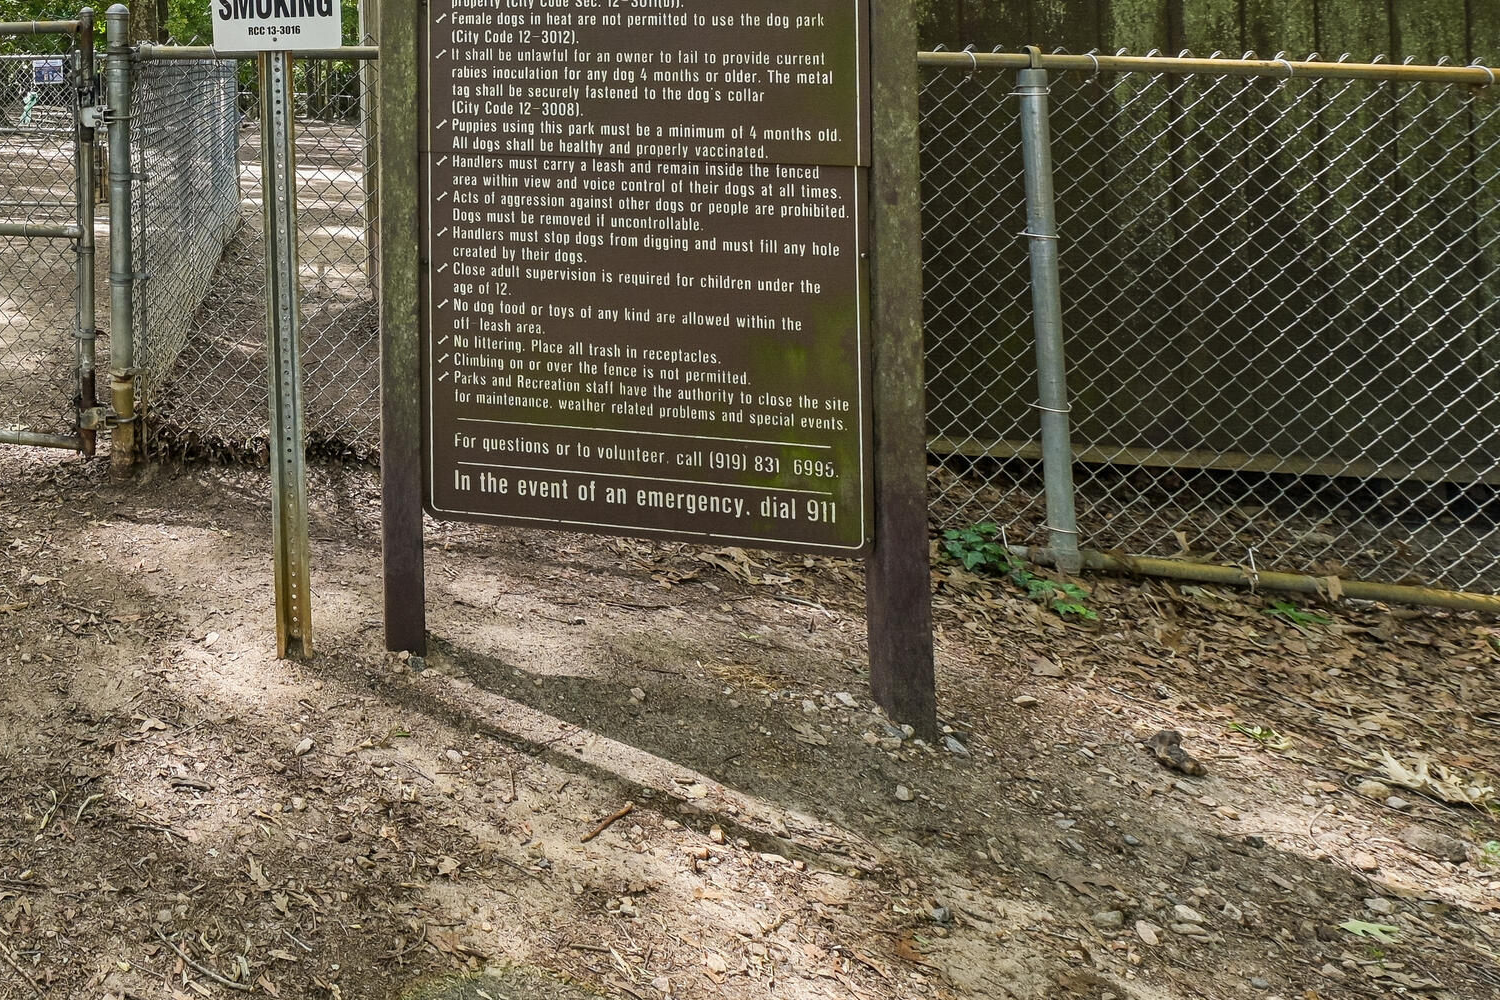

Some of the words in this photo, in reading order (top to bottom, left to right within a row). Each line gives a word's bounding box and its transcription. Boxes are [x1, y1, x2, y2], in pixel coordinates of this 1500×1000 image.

[248, 27, 266, 36] RCC
[267, 25, 301, 36] 13-3016
[451, 29, 479, 45] (City
[484, 29, 513, 43] Code
[451, 83, 470, 98] tag
[475, 83, 503, 96] shall
[508, 83, 522, 97] be
[527, 84, 579, 100] securely
[585, 84, 638, 99] fastened
[643, 86, 655, 100] to
[662, 86, 681, 100] the
[687, 86, 721, 103] dog's
[727, 87, 764, 102] collar
[451, 99, 479, 116] (City
[484, 100, 513, 115] Code
[451, 117, 497, 134] Puppies
[502, 119, 534, 135] using
[539, 119, 562, 134] this
[568, 121, 594, 137] park
[600, 122, 630, 136] must
[636, 122, 650, 136] be
[656, 125, 662, 137] a
[668, 123, 725, 138] minimum
[731, 125, 743, 139] of
[749, 125, 757, 139] 4
[763, 126, 811, 141] months
[817, 127, 841, 142] old.
[452, 135, 467, 149] All
[472, 136, 500, 152] dogs
[505, 137, 534, 151] shall
[539, 137, 553, 152] be
[559, 138, 603, 155] healthy
[609, 140, 630, 154] and
[636, 141, 688, 158] properly
[694, 143, 768, 158] vaccinated.
[452, 189, 479, 204] Acts
[484, 190, 495, 204] of
[500, 191, 564, 209] aggression
[570, 194, 612, 211] against
[618, 195, 650, 210] other
[655, 197, 684, 214] dogs
[690, 201, 703, 212] or
[708, 199, 748, 216] people
[754, 203, 774, 215] are
[780, 202, 849, 220] prohibited.
[453, 282, 473, 296] age
[478, 280, 489, 294] of
[494, 281, 511, 296] 12.
[453, 334, 468, 348] No
[474, 335, 525, 354] littering.
[531, 338, 563, 354] Place
[568, 341, 582, 355] all
[588, 342, 620, 358] trash
[626, 344, 637, 358] in
[643, 346, 721, 366] receptacles.
[454, 431, 476, 449] For
[482, 434, 549, 457] questions
[556, 443, 570, 456] or
[576, 441, 590, 458] to
[676, 449, 701, 467] call
[709, 450, 746, 471] (919)
[454, 469, 470, 491] In
[479, 471, 508, 494] the
[517, 475, 568, 499] event
[577, 479, 595, 502] of
[605, 486, 626, 505] an
[760, 495, 796, 519] dial
[806, 498, 835, 523] 911
